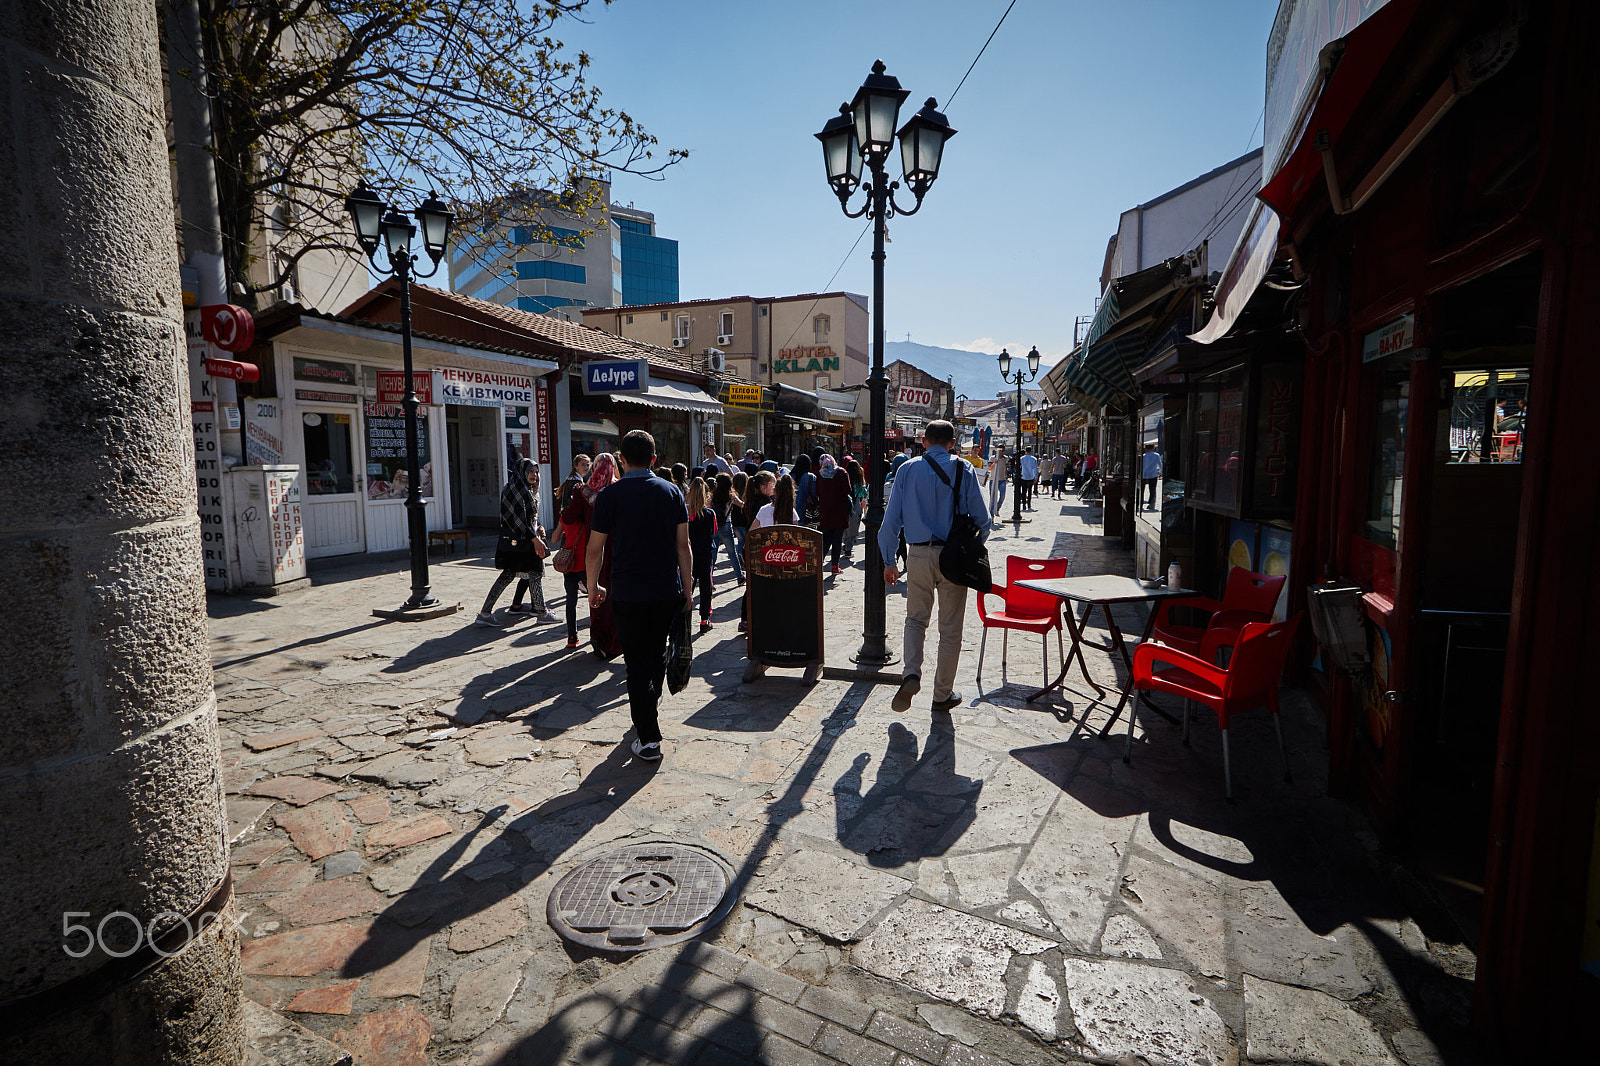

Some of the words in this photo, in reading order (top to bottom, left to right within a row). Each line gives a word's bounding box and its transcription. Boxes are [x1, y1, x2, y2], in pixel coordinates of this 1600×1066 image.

[779, 346, 836, 359] HOTEL
[774, 357, 839, 374] KLAN
[442, 383, 531, 402] KËMBIMORE
[899, 388, 931, 405] FOTO
[257, 403, 277, 418] 2001
[537, 390, 549, 462] МЕНУВАЧНИЦА
[269, 480, 284, 573] MENUVACNICA
[765, 549, 800, 563] Coca-Cola
